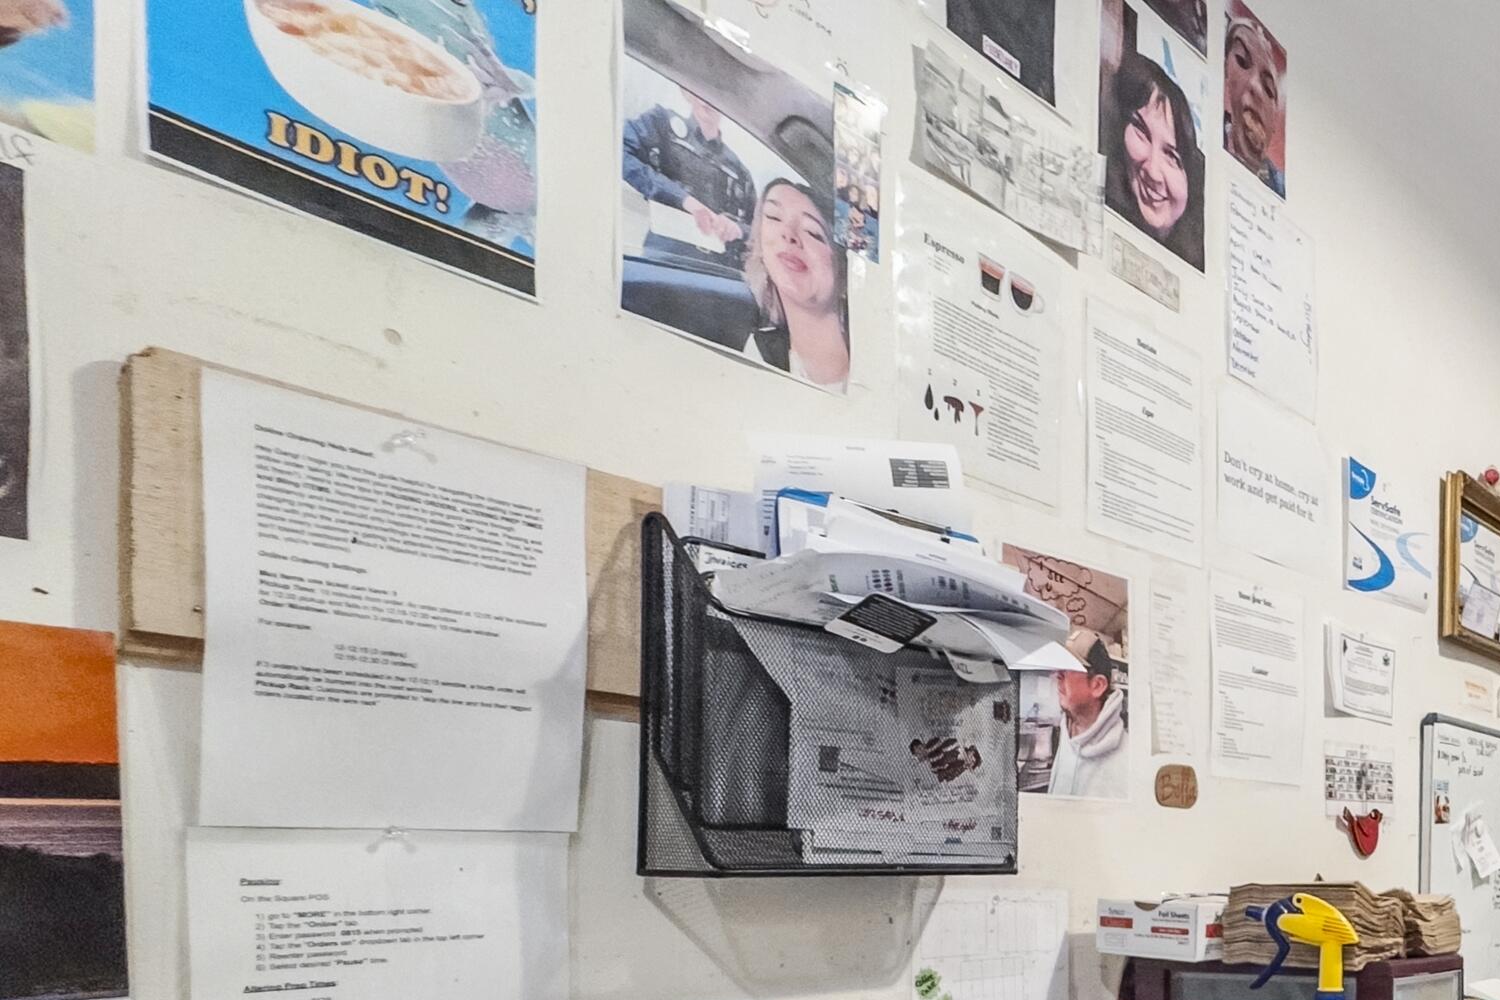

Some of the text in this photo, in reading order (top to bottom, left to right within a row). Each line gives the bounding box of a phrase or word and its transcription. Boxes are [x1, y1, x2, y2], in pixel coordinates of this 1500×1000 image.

[264, 109, 450, 215] IDIOT!
[923, 232, 966, 265] Espresso
[1224, 450, 1248, 473] Don't
[1249, 465, 1264, 481] cry
[1265, 472, 1274, 484] at
[1298, 490, 1310, 504] cry
[1311, 496, 1319, 506] at
[1224, 473, 1247, 490] work
[1247, 484, 1263, 498] and
[1265, 491, 1278, 504] get
[1279, 498, 1296, 513] paid
[1296, 503, 1306, 518] for
[703, 552, 749, 569] Invoices
